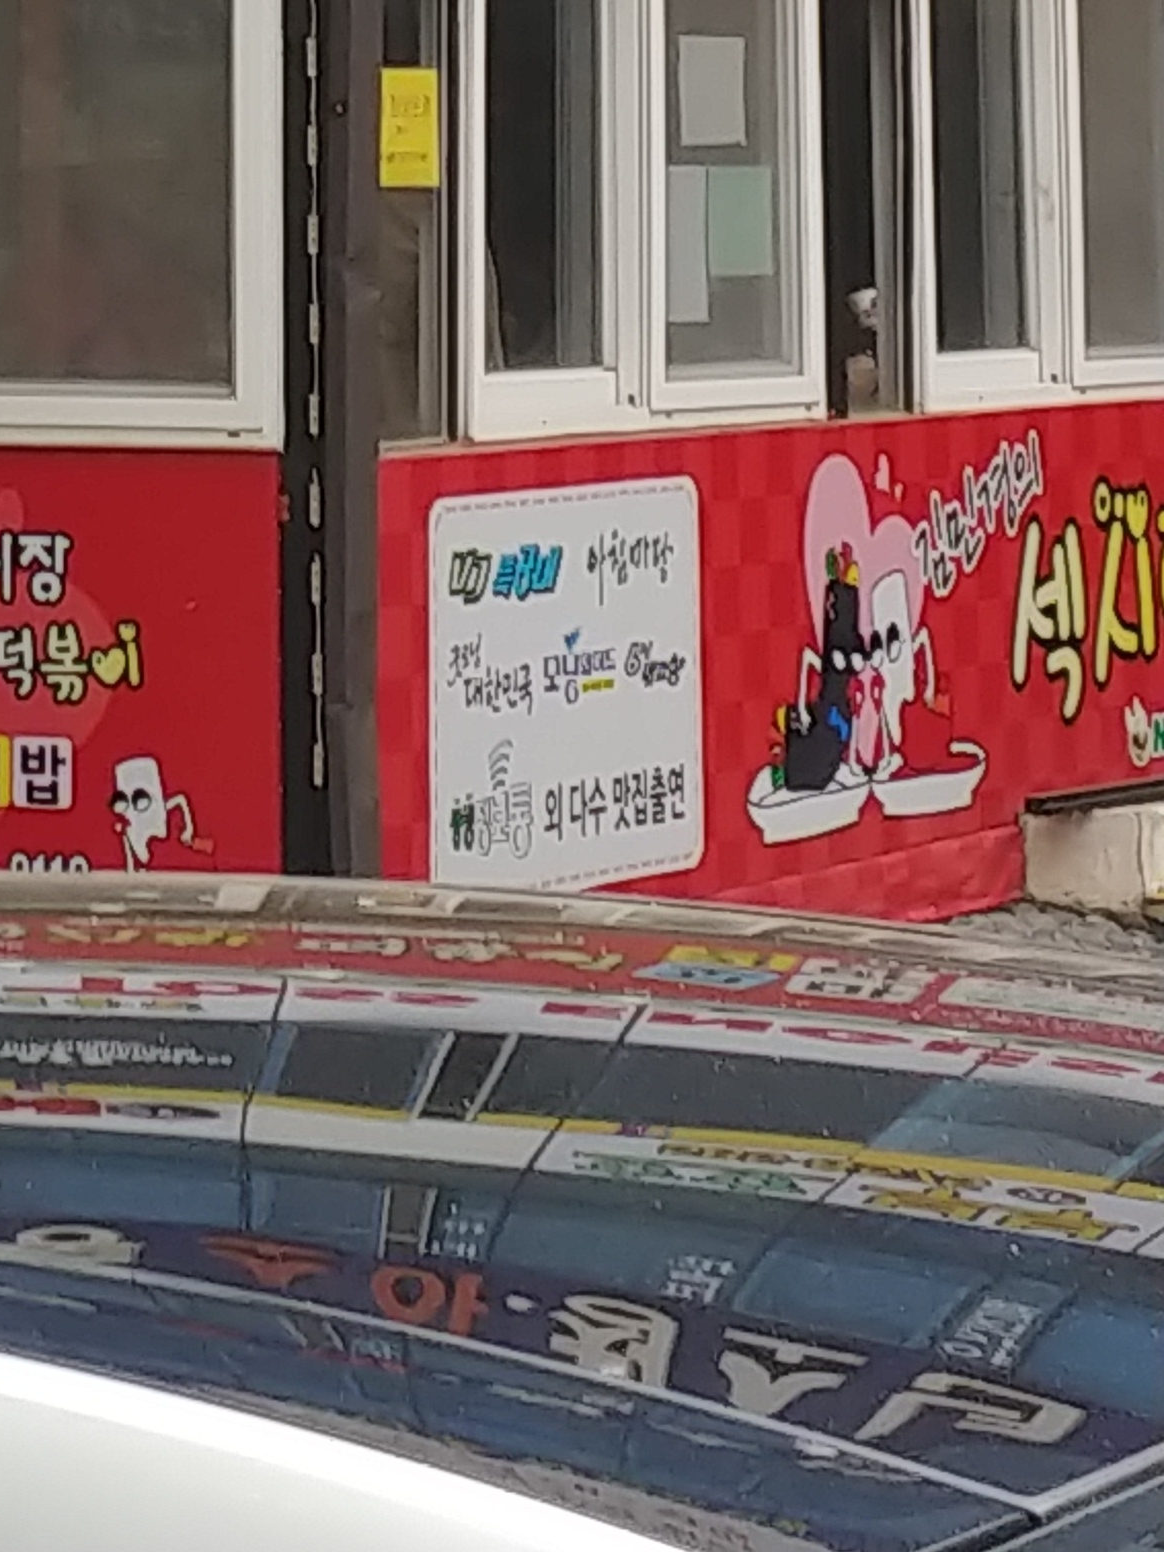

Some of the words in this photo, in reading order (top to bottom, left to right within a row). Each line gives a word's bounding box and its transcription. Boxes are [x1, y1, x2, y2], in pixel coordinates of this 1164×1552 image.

[1010, 474, 1164, 728] 섹시
[543, 781, 564, 842] 외
[569, 775, 608, 839] 다수
[612, 762, 686, 833] 맛집출연
